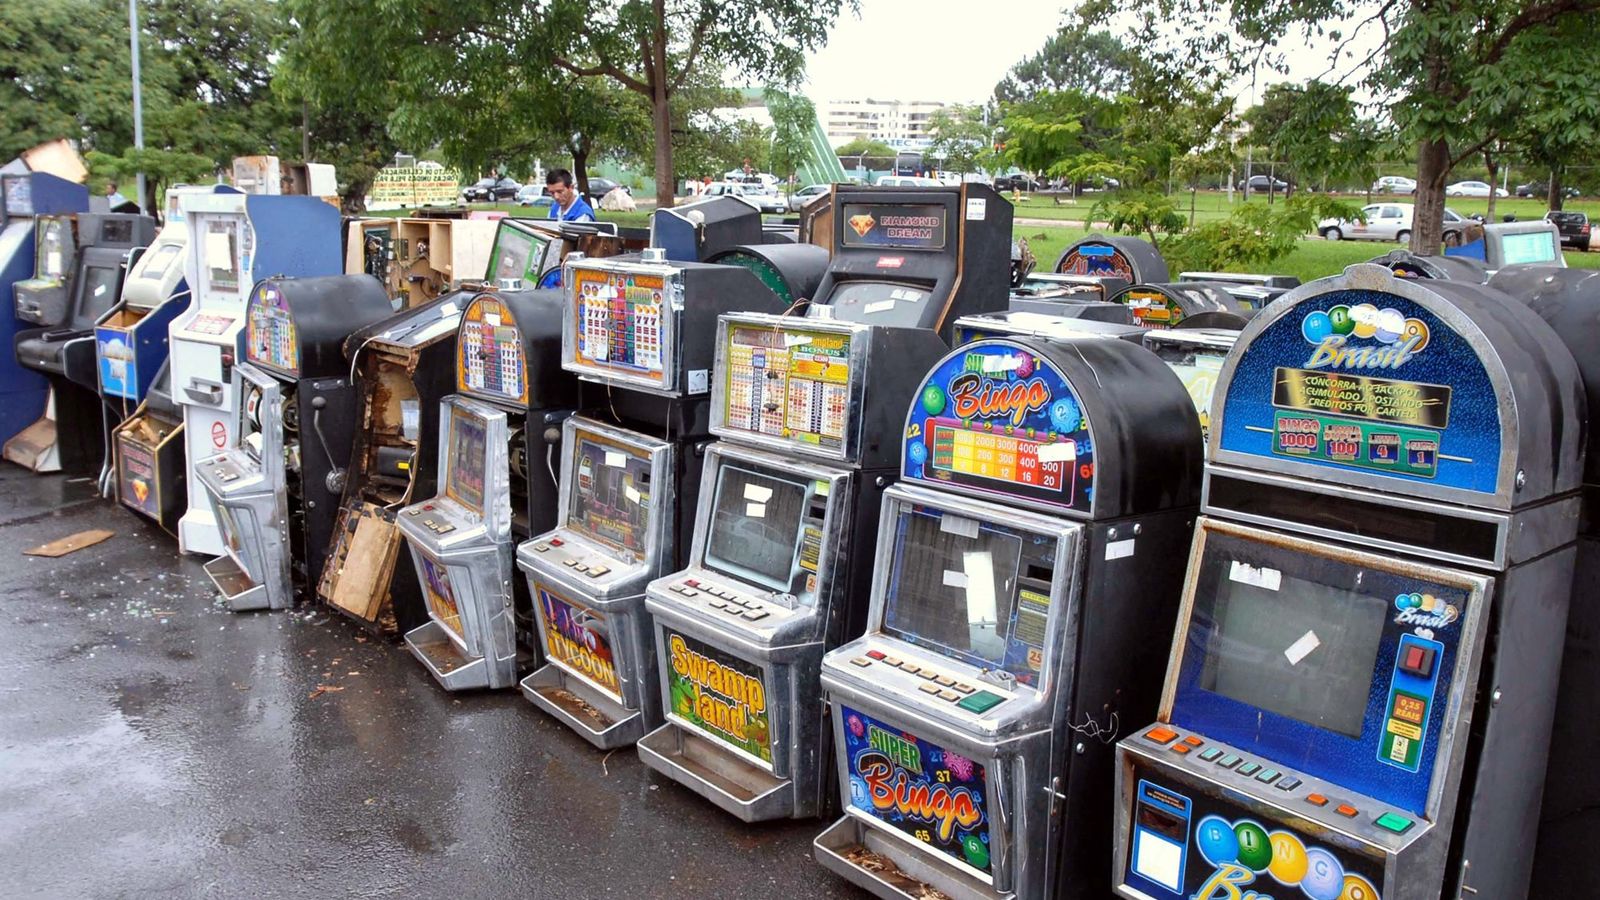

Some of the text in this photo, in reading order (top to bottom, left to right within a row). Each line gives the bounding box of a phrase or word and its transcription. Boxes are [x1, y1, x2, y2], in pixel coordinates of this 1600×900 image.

[880, 215, 940, 227] DIAMOND
[887, 227, 932, 239] DREAM
[800, 345, 841, 356] BONUS
[1303, 334, 1423, 369] Brasil
[1301, 386, 1360, 402] ACUMULADO
[1305, 376, 1356, 391] CONCORRA
[1374, 384, 1420, 398] JACKPOT
[951, 374, 1048, 426] Bingo
[1355, 402, 1374, 415] POR
[1278, 418, 1320, 433] BINGO
[976, 435, 996, 447] 2000
[997, 439, 1017, 451] 3000
[1018, 443, 1039, 455] 4000
[1280, 433, 1317, 448] 1000
[1330, 441, 1357, 455] 100
[1376, 445, 1388, 458] 4
[1417, 451, 1425, 463] 1
[977, 449, 992, 461] 200
[999, 453, 1014, 465] 300
[1020, 457, 1036, 469] 400
[1041, 461, 1059, 473] 500
[1001, 468, 1010, 478] 12
[1022, 471, 1033, 482] 16
[1043, 475, 1056, 486] 20
[1394, 607, 1451, 629] Brasil
[1029, 650, 1041, 663] 25
[669, 633, 766, 714] Swamp
[692, 680, 748, 743] land
[1395, 707, 1421, 721] REAIS
[868, 724, 922, 774] SUPER
[936, 770, 951, 783] 37
[858, 751, 982, 841] Bingo
[915, 829, 930, 843] 65
